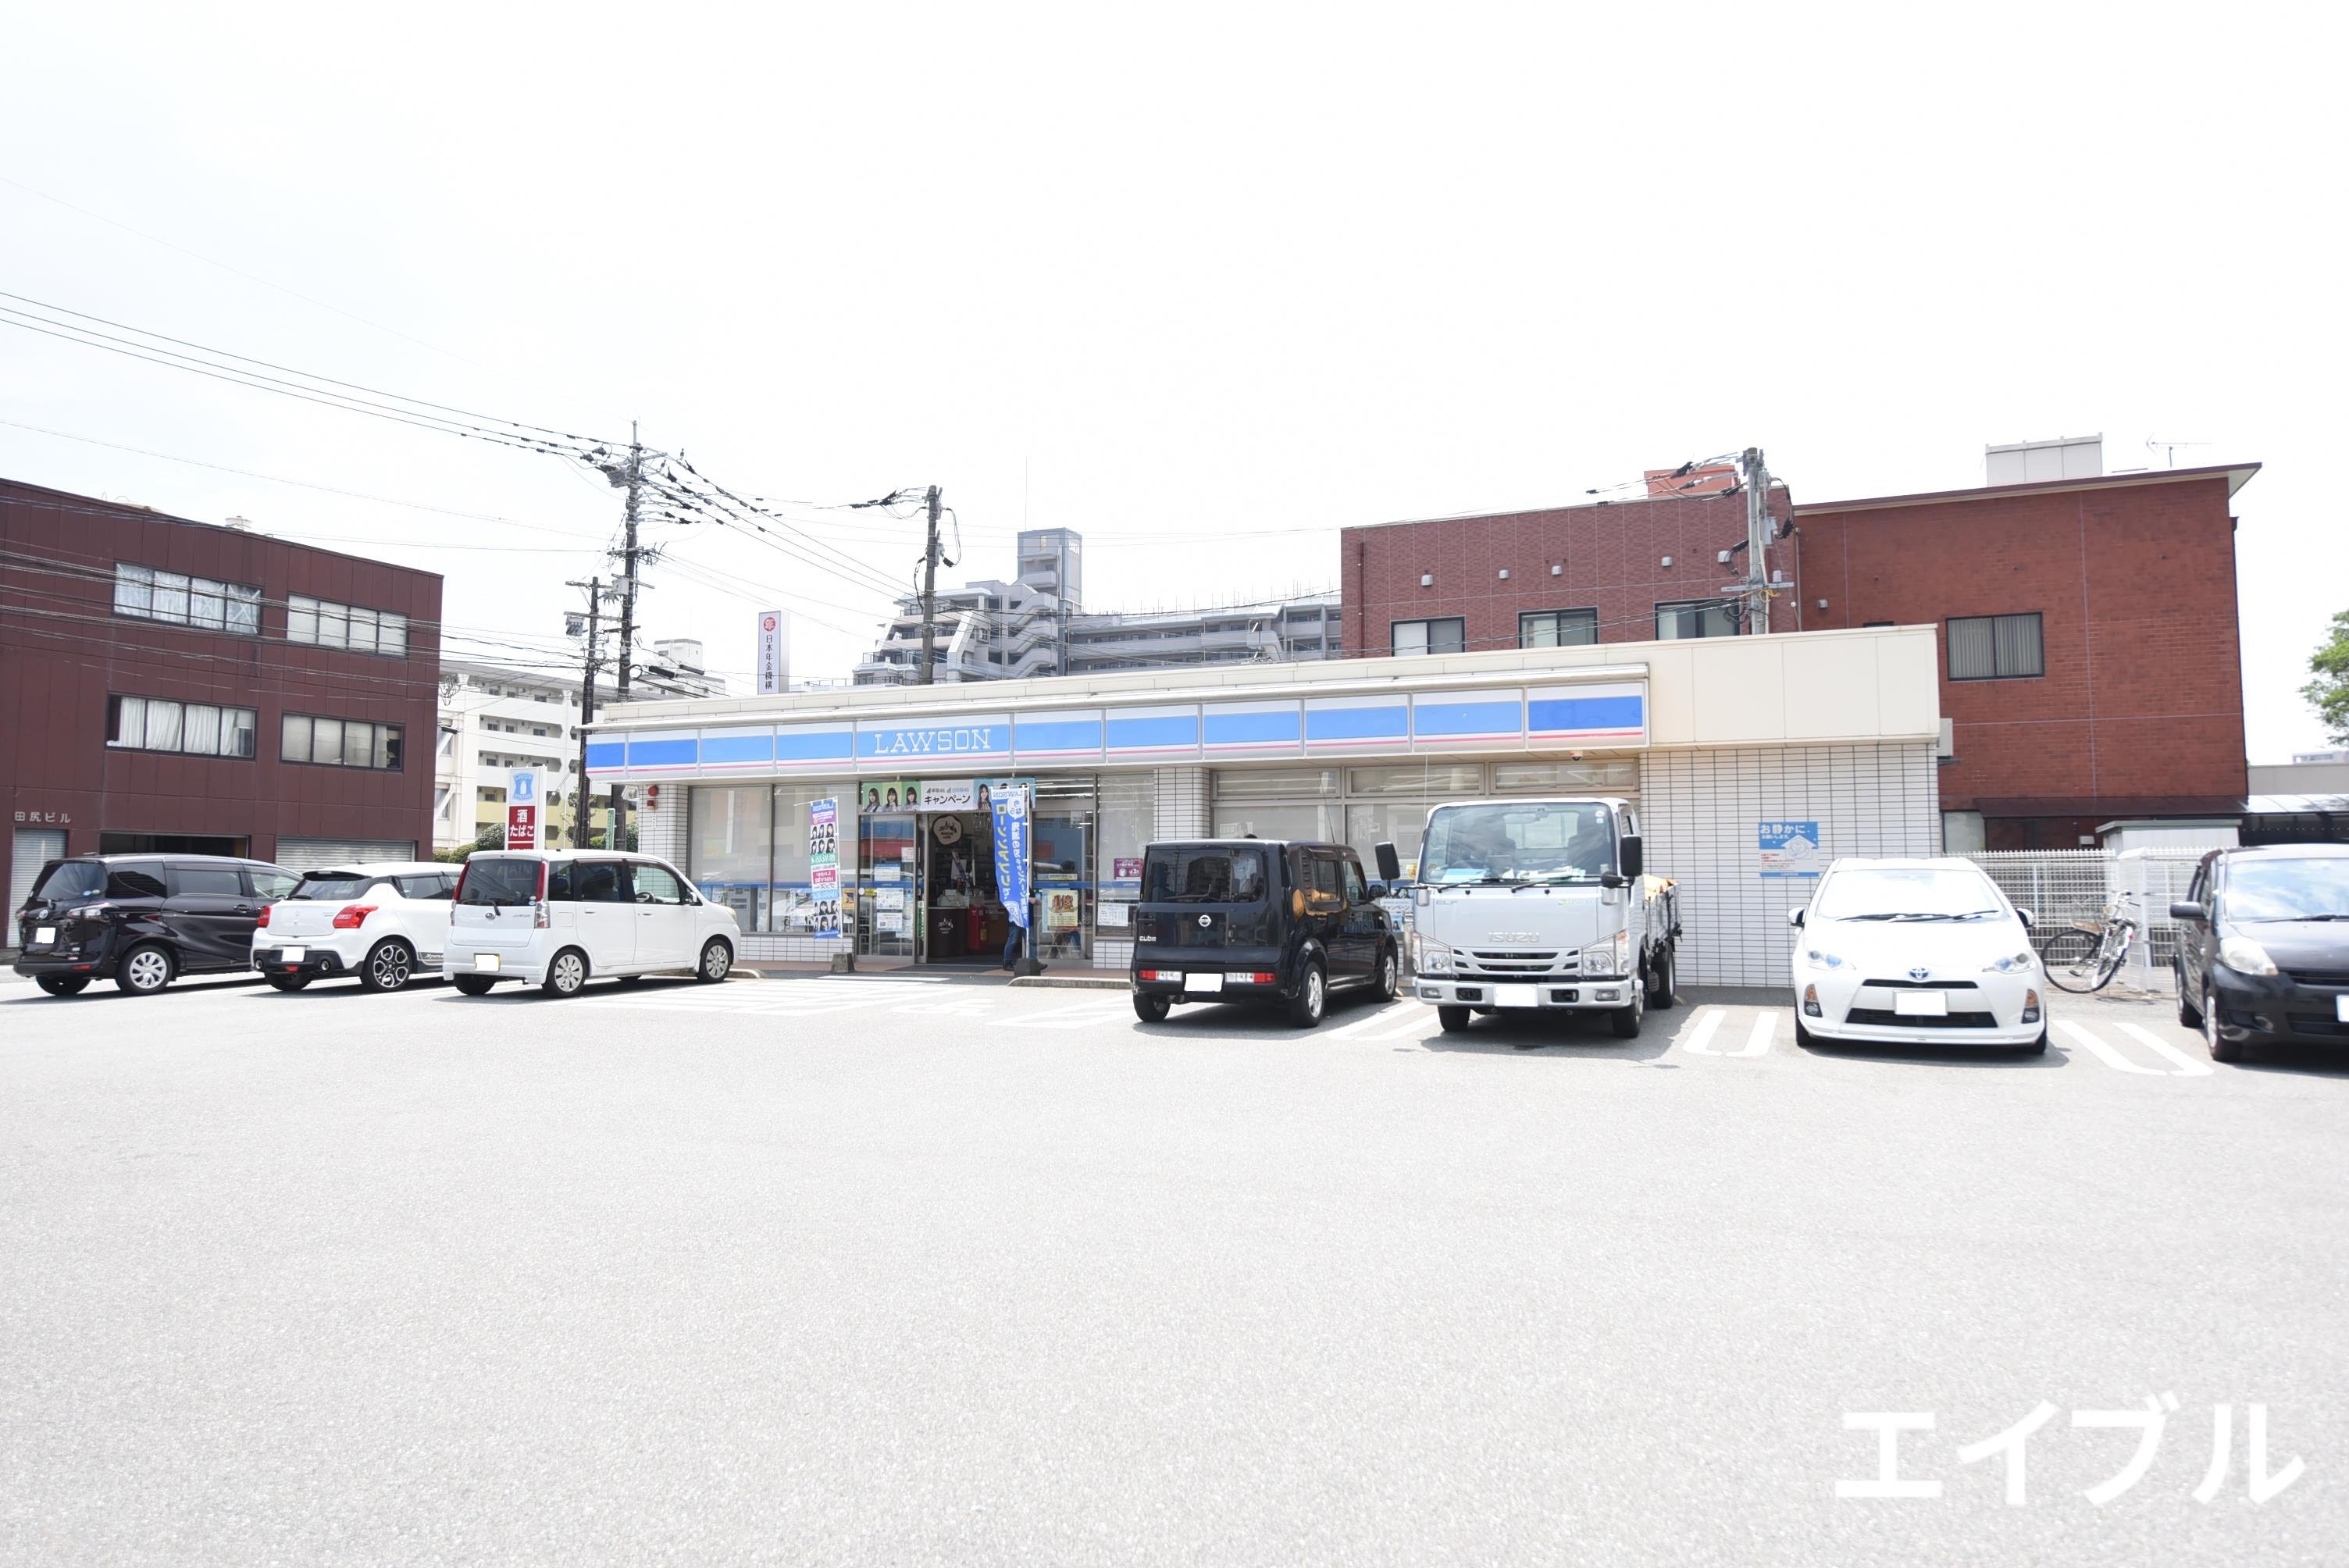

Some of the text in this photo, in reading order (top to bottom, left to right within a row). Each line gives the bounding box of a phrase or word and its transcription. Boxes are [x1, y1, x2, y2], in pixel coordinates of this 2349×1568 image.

[874, 729, 991, 754] LAWSON
[924, 794, 971, 805] キャンペーン
[15, 811, 71, 823] 田尻ビル
[517, 809, 528, 823] 酒
[509, 825, 534, 837] たばこ
[1488, 932, 1540, 943] ISUZU
